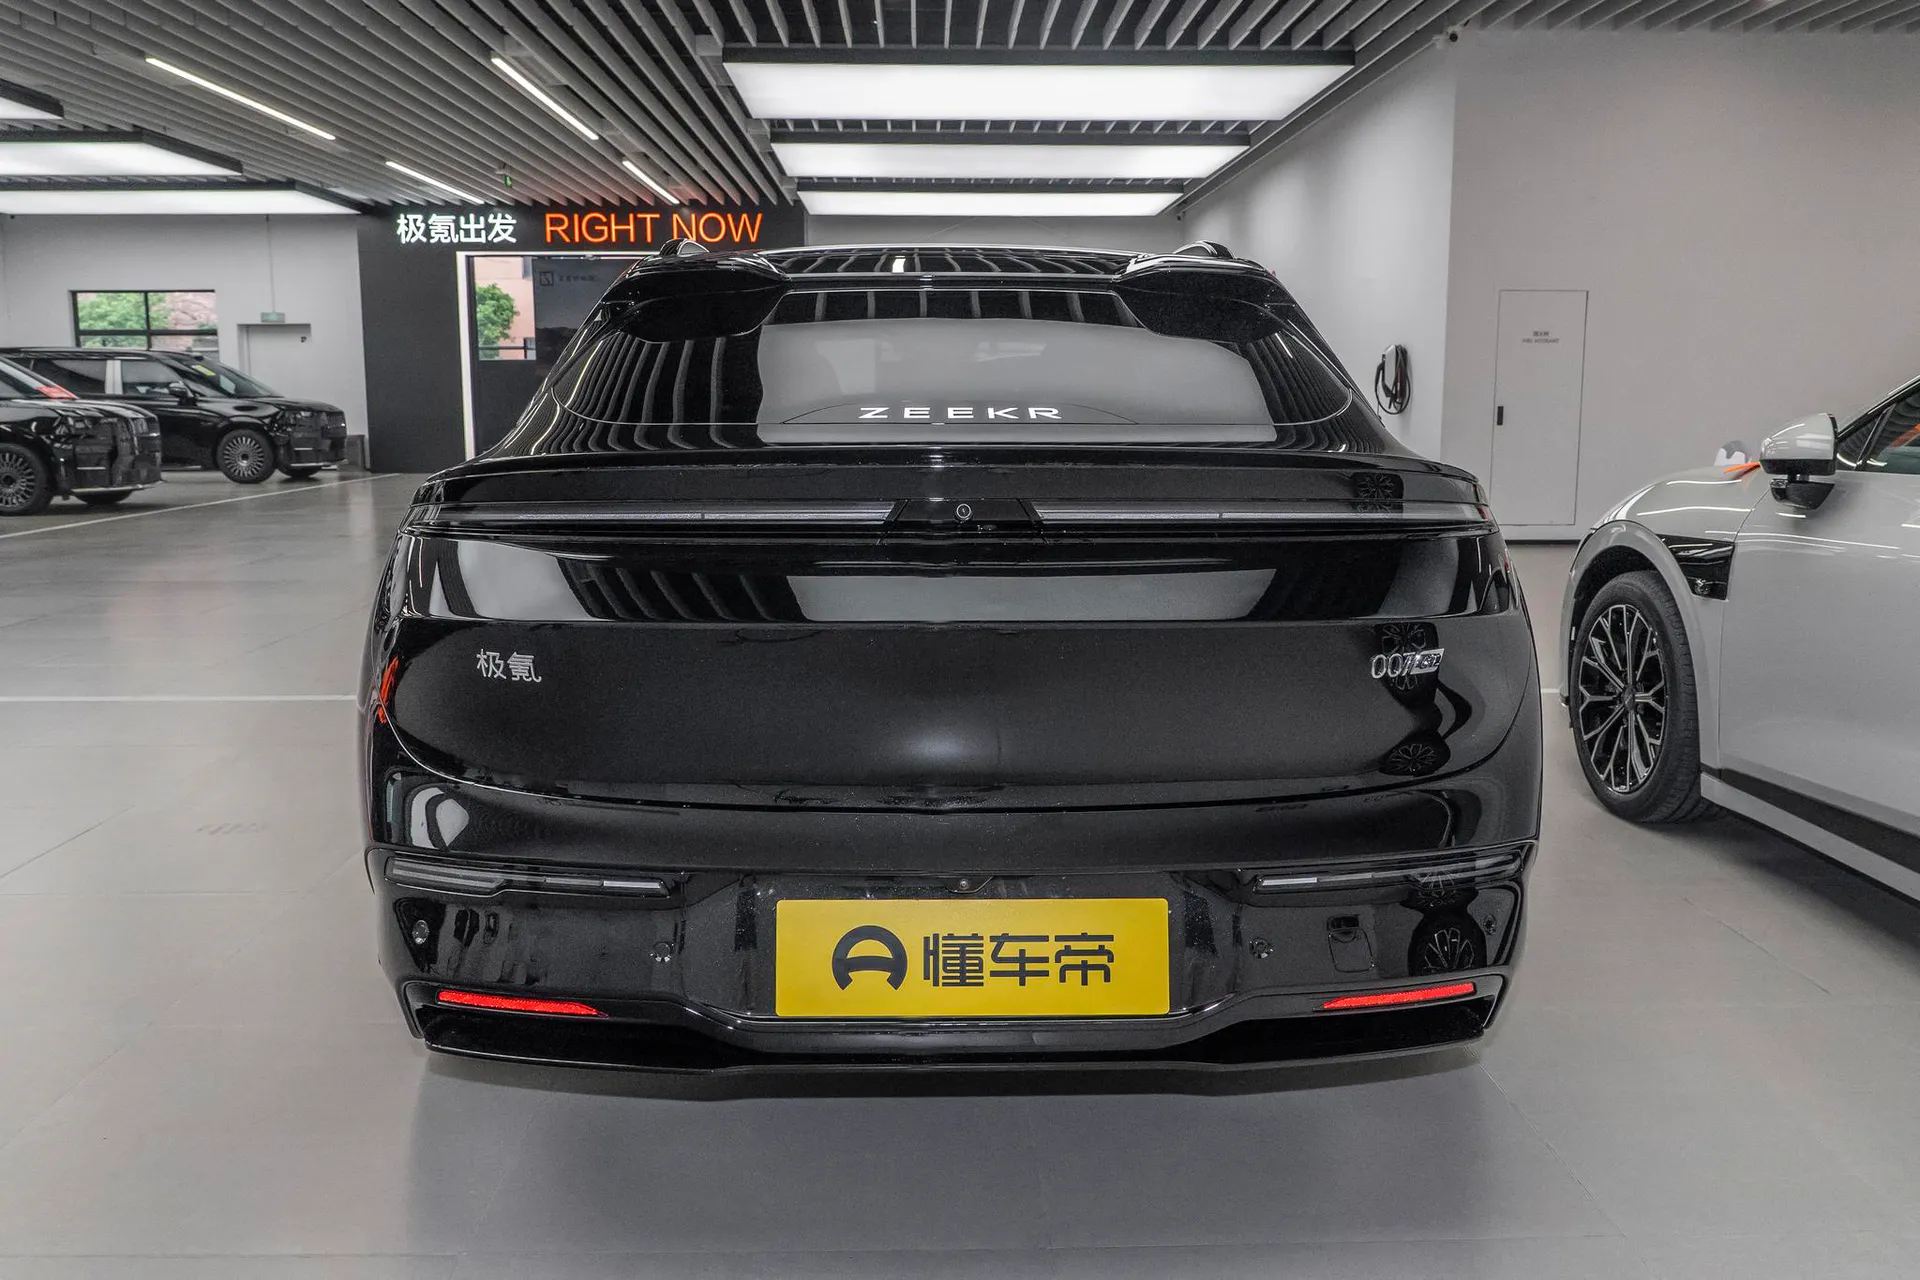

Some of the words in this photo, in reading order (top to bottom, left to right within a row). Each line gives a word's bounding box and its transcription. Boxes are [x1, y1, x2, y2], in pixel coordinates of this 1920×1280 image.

[396, 212, 518, 244] 极氪出发
[545, 212, 661, 244] RIGHT
[672, 212, 765, 244] NOW
[857, 406, 1063, 420] ZEEKR
[475, 648, 542, 683] 极氪
[922, 932, 1115, 988] 懂车帝
